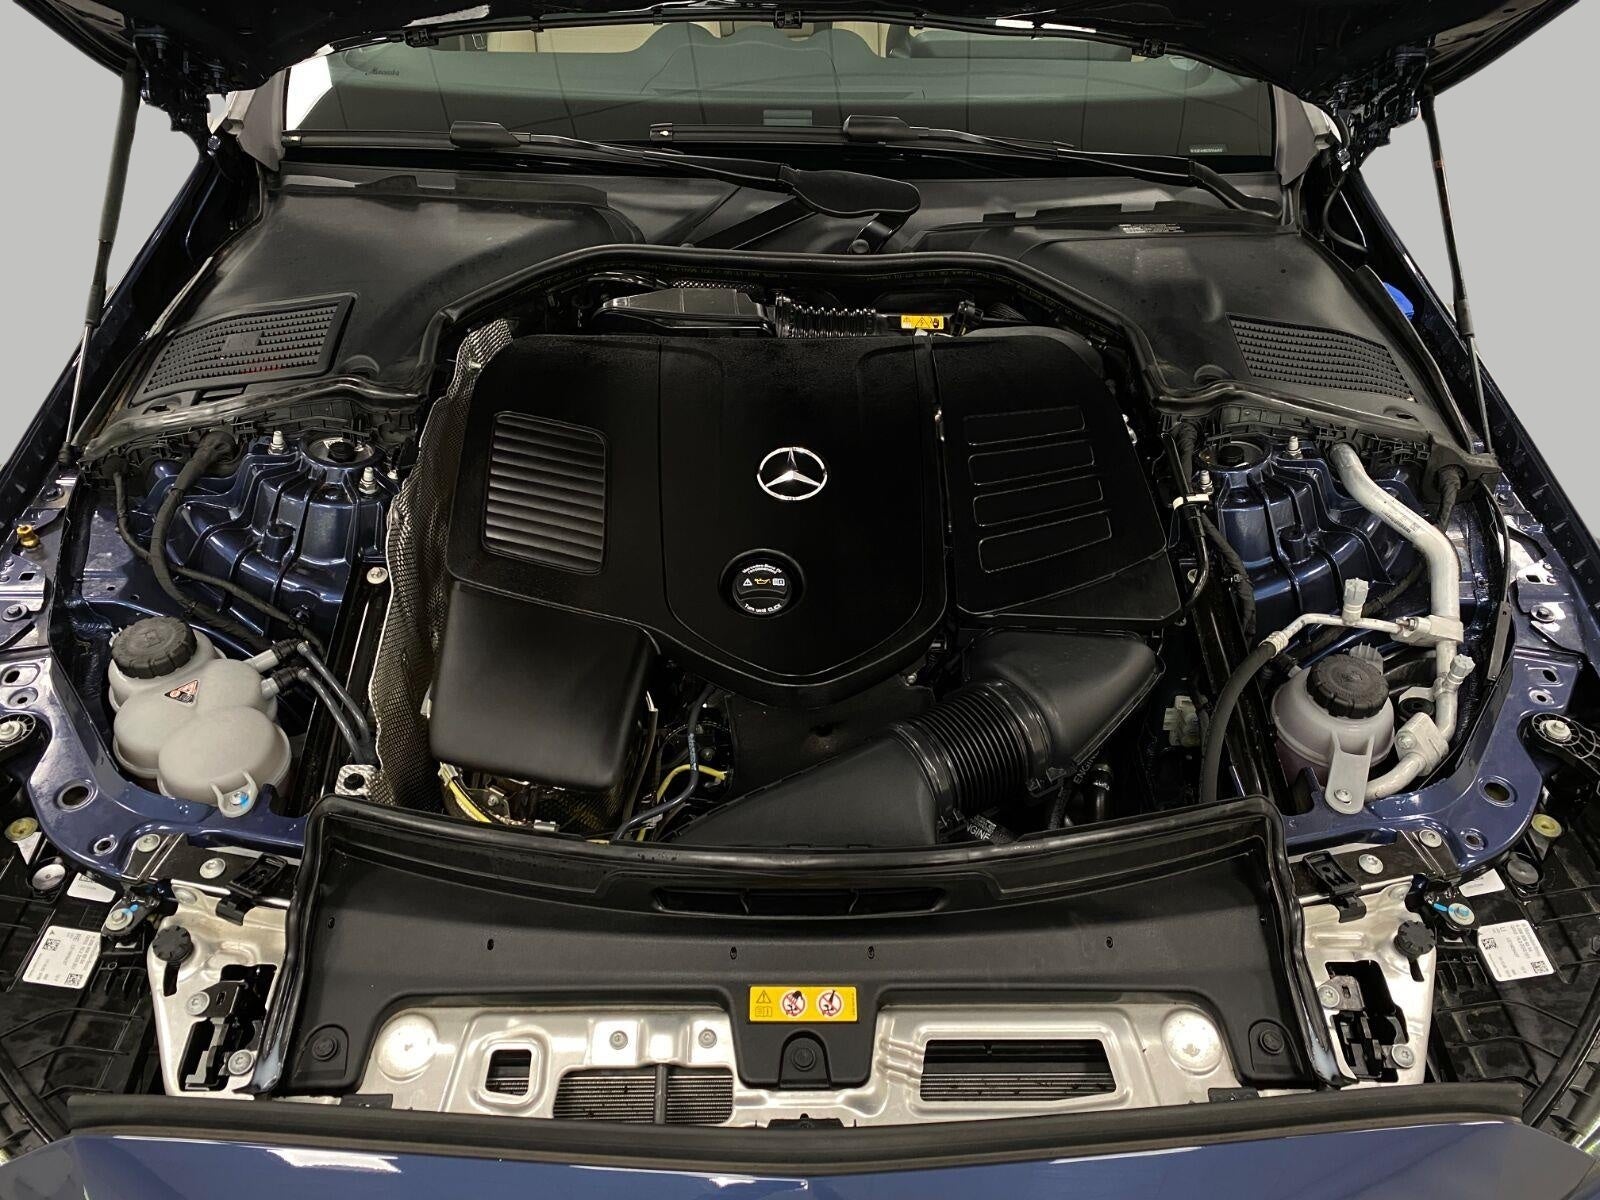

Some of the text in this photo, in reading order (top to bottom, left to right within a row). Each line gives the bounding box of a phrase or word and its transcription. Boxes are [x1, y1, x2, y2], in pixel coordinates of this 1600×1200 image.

[744, 603, 755, 611] Turn
[767, 603, 781, 612] CLICK
[966, 821, 991, 840] NGINE
